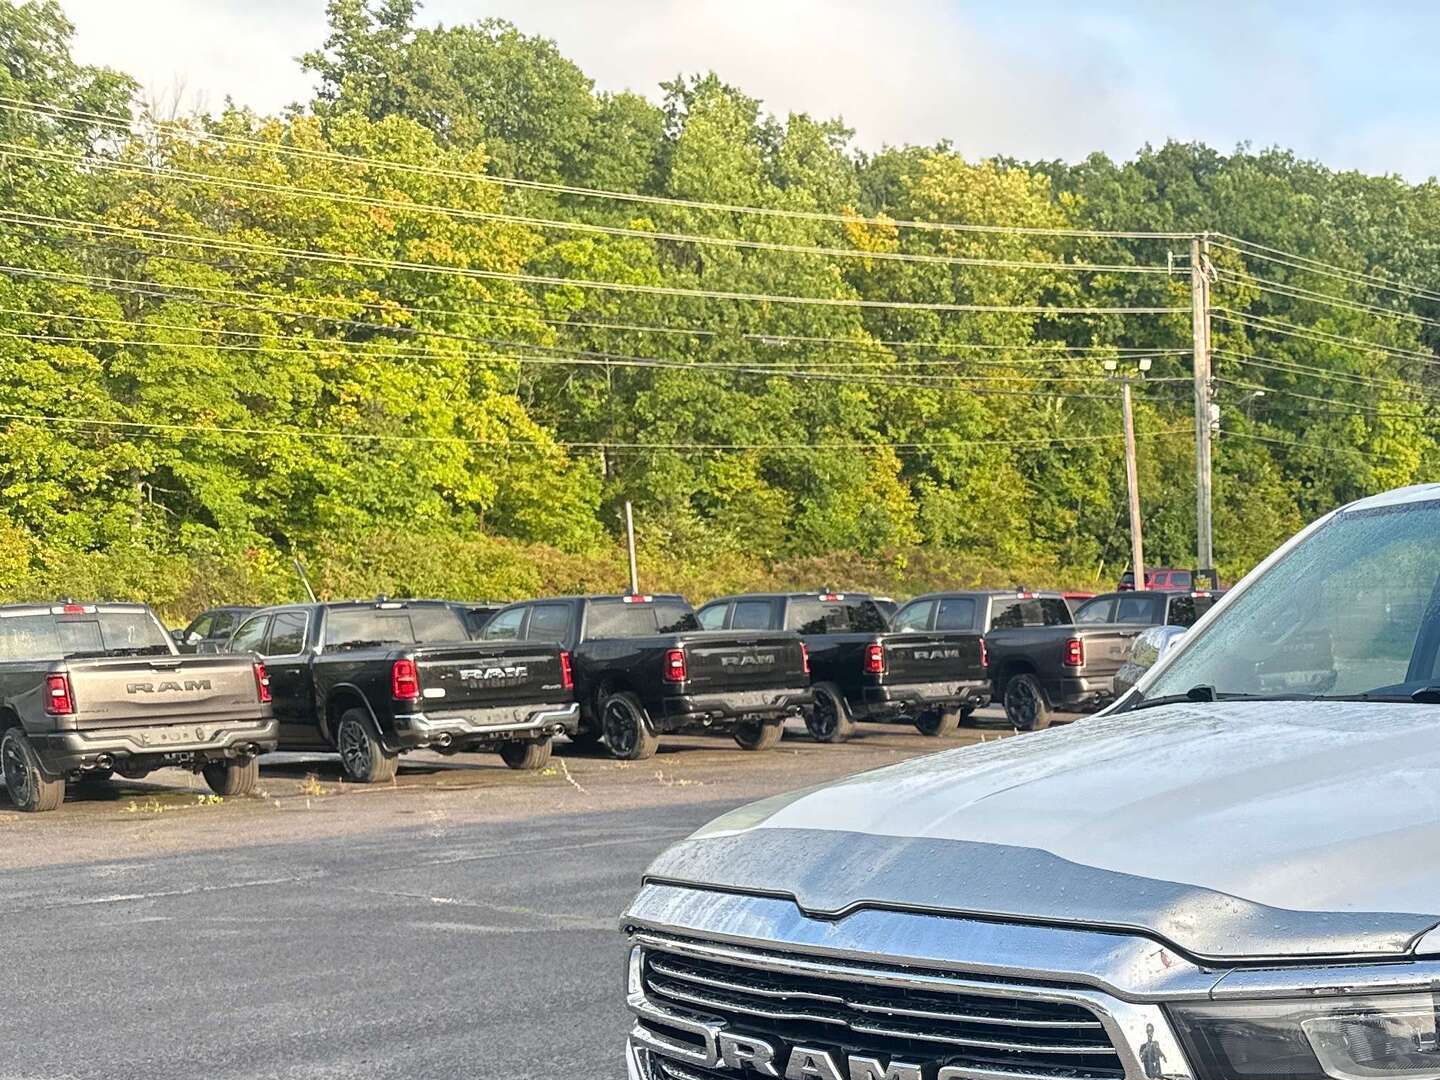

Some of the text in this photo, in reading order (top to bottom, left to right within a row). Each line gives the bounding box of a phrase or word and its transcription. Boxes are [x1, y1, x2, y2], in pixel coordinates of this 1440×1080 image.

[721, 654, 776, 667] RAM
[913, 649, 961, 661] RAM
[459, 666, 529, 681] RAM
[126, 679, 212, 694] RAM
